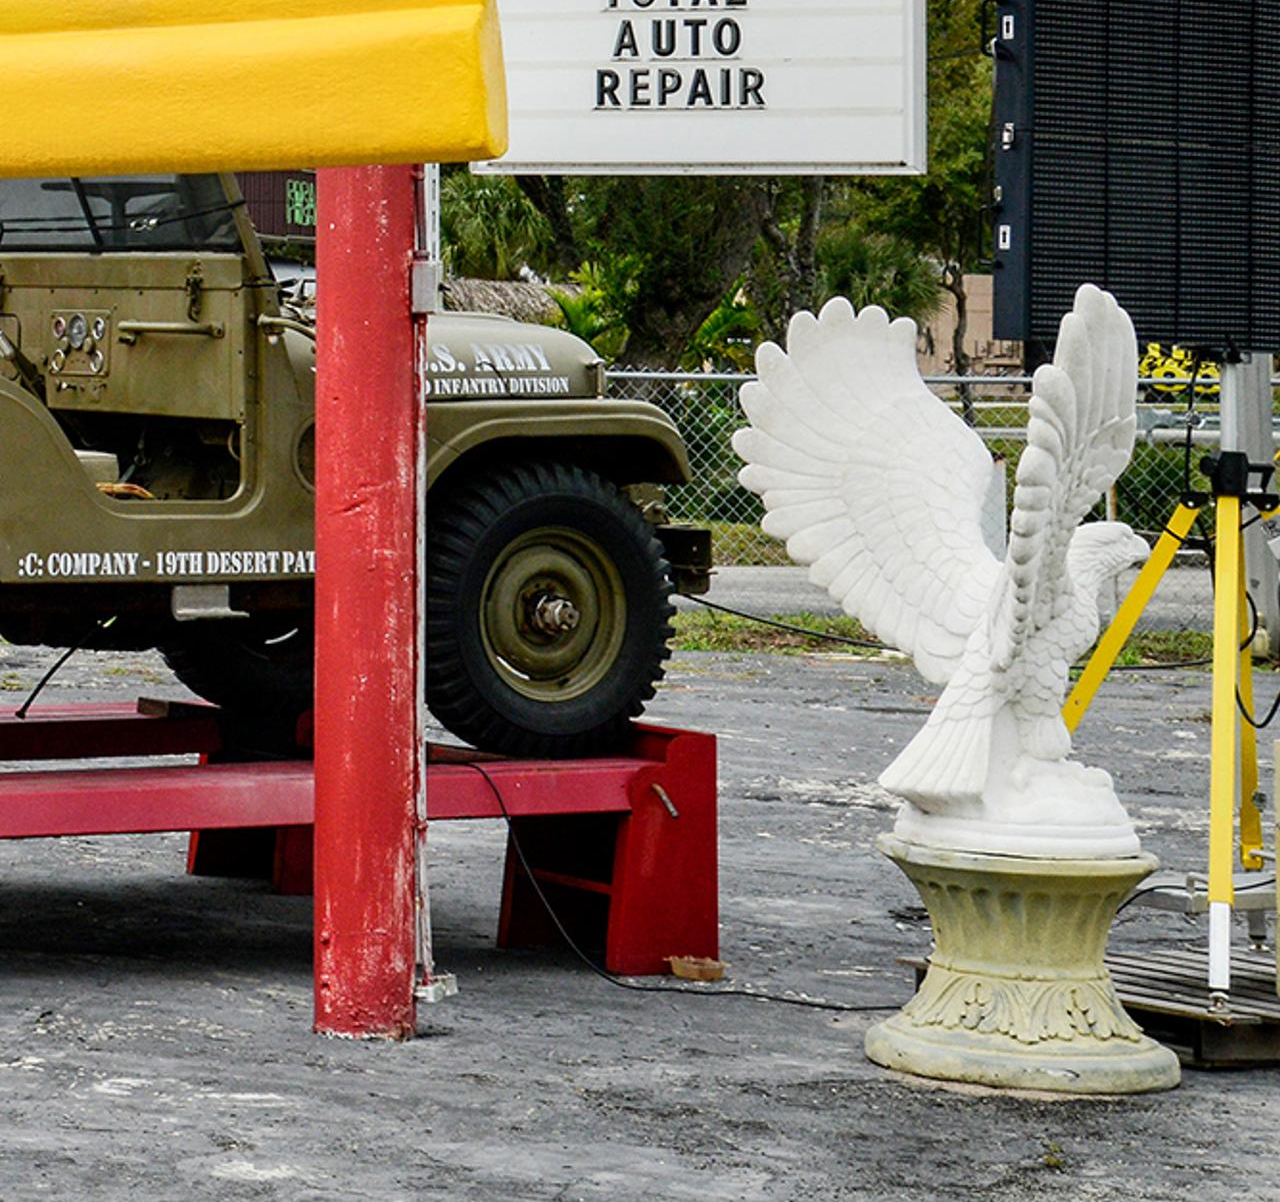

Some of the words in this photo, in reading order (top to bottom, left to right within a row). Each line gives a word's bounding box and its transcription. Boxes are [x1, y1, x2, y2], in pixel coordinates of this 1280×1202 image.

[613, 17, 741, 57] AUTO
[596, 67, 766, 106] REPAIR
[426, 342, 467, 372] .S.
[471, 342, 552, 372] ARMY
[434, 377, 508, 395] INFANTRY
[509, 376, 570, 394] DIVISION
[47, 552, 139, 576] COMPANY
[156, 552, 203, 575] 19TH
[206, 551, 280, 574] DESERT
